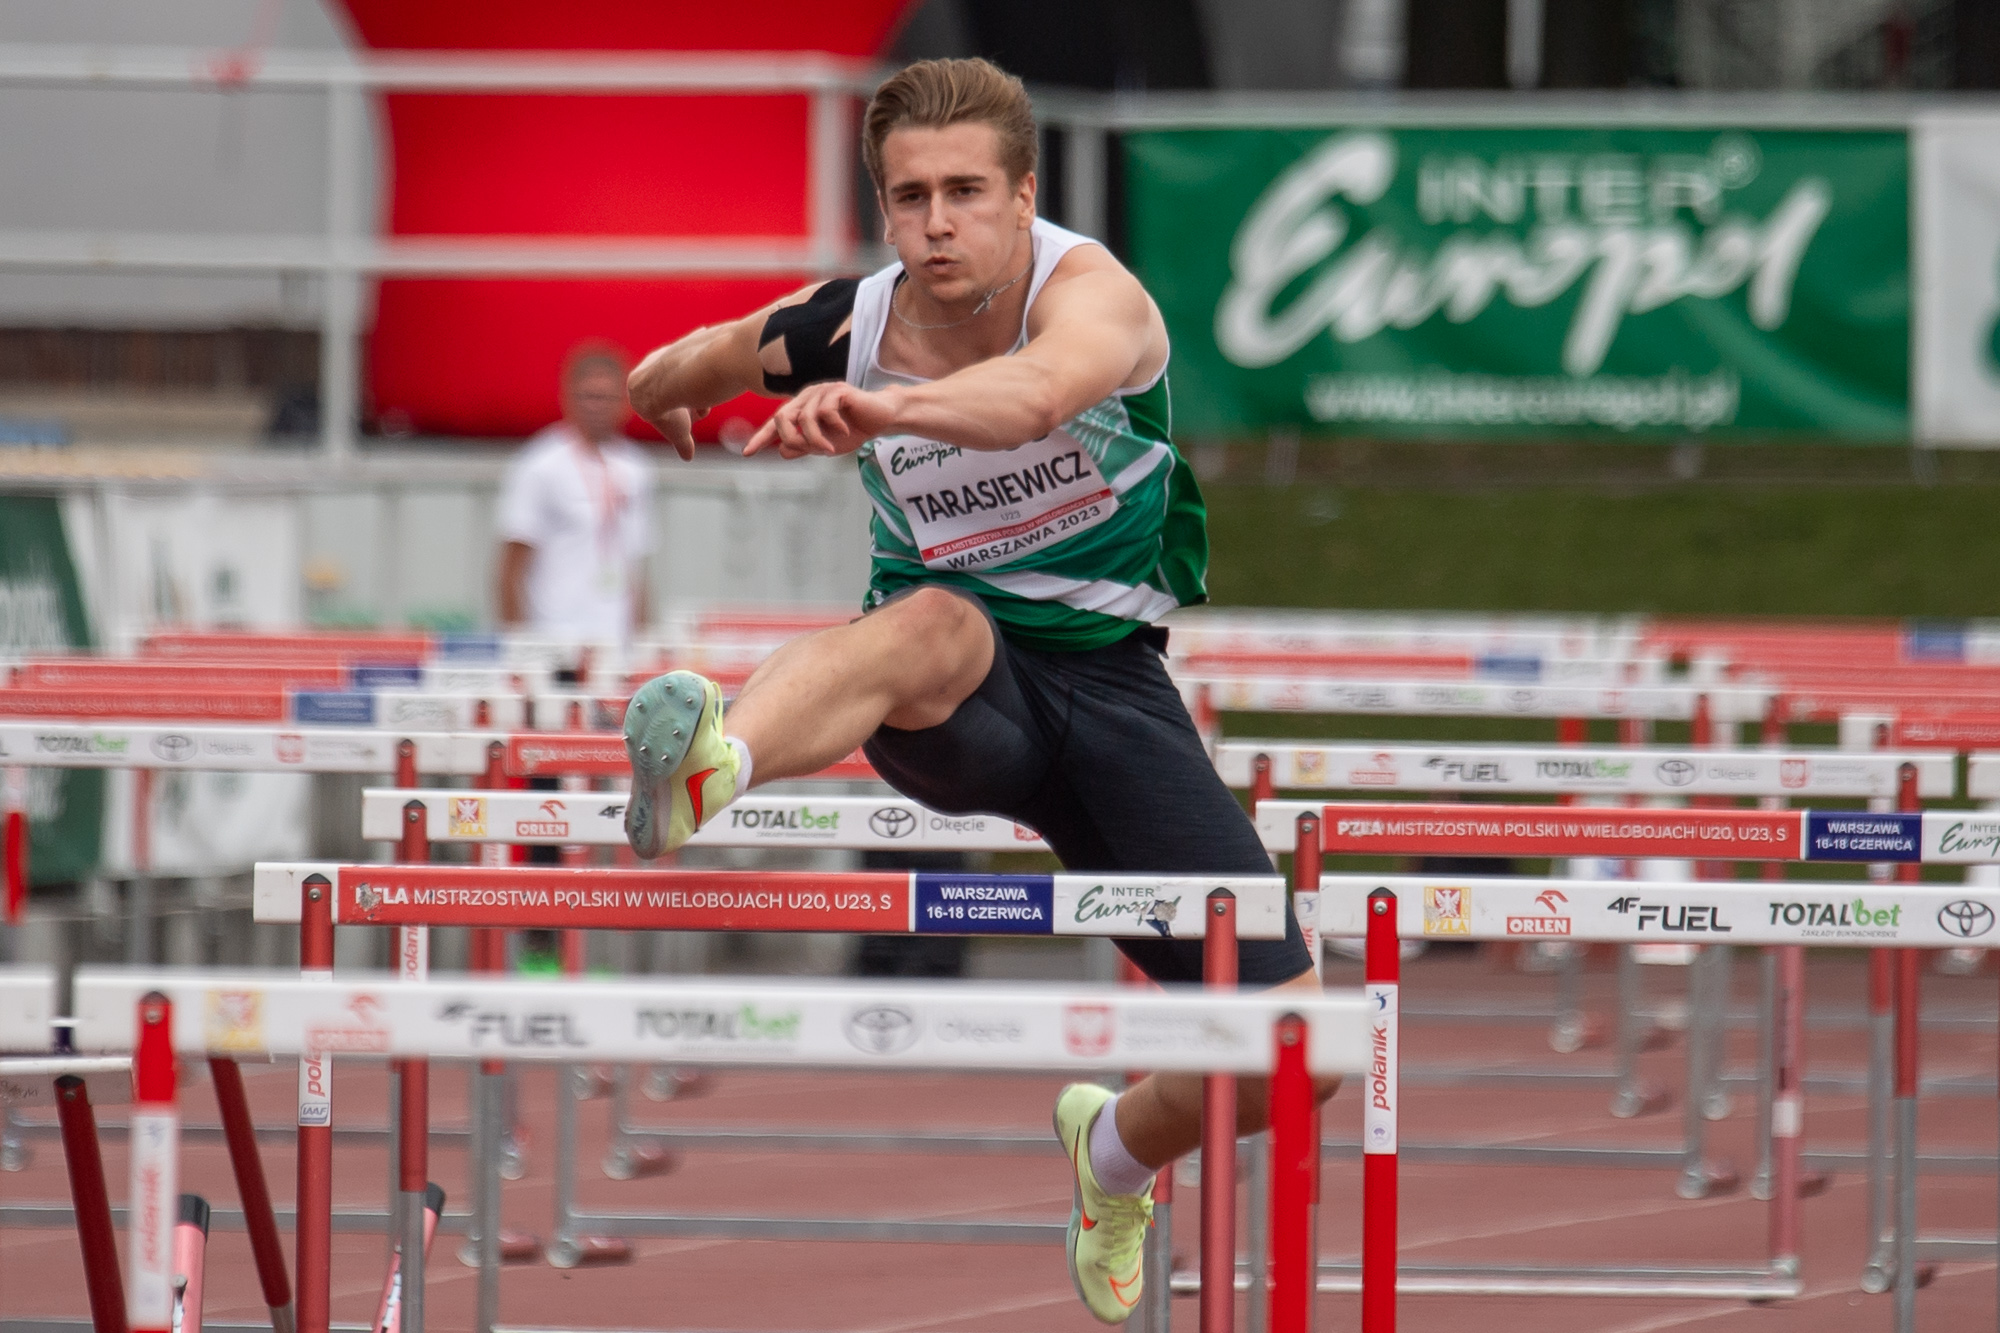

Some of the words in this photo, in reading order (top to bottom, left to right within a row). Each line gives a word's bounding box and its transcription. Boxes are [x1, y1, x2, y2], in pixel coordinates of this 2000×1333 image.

[1417, 153, 1722, 227] INTER
[1214, 128, 1831, 376] Europol
[906, 451, 1092, 524] TARASIEWICZ
[1000, 510, 1021, 522] U23
[946, 526, 1056, 570] WARSZAWA
[1057, 505, 1101, 532] 2023
[1441, 762, 1511, 783] FUEL
[519, 823, 566, 836] ORLEN
[598, 805, 625, 820] 4F
[731, 806, 839, 830] TOTALbet
[930, 818, 986, 835] Okęcie
[1827, 822, 1900, 835] WARSZAWA
[1970, 824, 2000, 834] INTE
[1387, 821, 1502, 837] MISTRZOSTWA
[1504, 822, 1559, 838] POLSKI
[1563, 824, 1579, 838] W
[1582, 824, 1695, 840] WIELOBOJACH
[1700, 826, 1736, 844] U20,
[1738, 827, 1774, 844] U23,
[1776, 827, 1786, 842] S
[1816, 838, 1847, 850] 16-18
[1850, 839, 1913, 851] CZERWCA
[414, 889, 550, 908] MISTRZOSTWA
[554, 891, 620, 908] POLSKI
[624, 891, 643, 907] W
[647, 891, 782, 909] WIELOBOJACH
[788, 894, 830, 912] U20,
[834, 894, 876, 912] U23,
[880, 894, 891, 910] S
[940, 887, 1028, 901] WARSZAWA
[1111, 886, 1155, 898] INTER
[926, 905, 963, 919] 16-18
[967, 906, 1043, 921] CZERWCA
[1509, 917, 1567, 934] ORLEN
[1607, 896, 1641, 914] 4F
[1637, 905, 1733, 932] FUEL
[1769, 897, 1902, 927] TOTALbet
[470, 1012, 588, 1048] FUEL
[1369, 1024, 1391, 1112] polanik
[302, 1104, 328, 1116] IAAF
